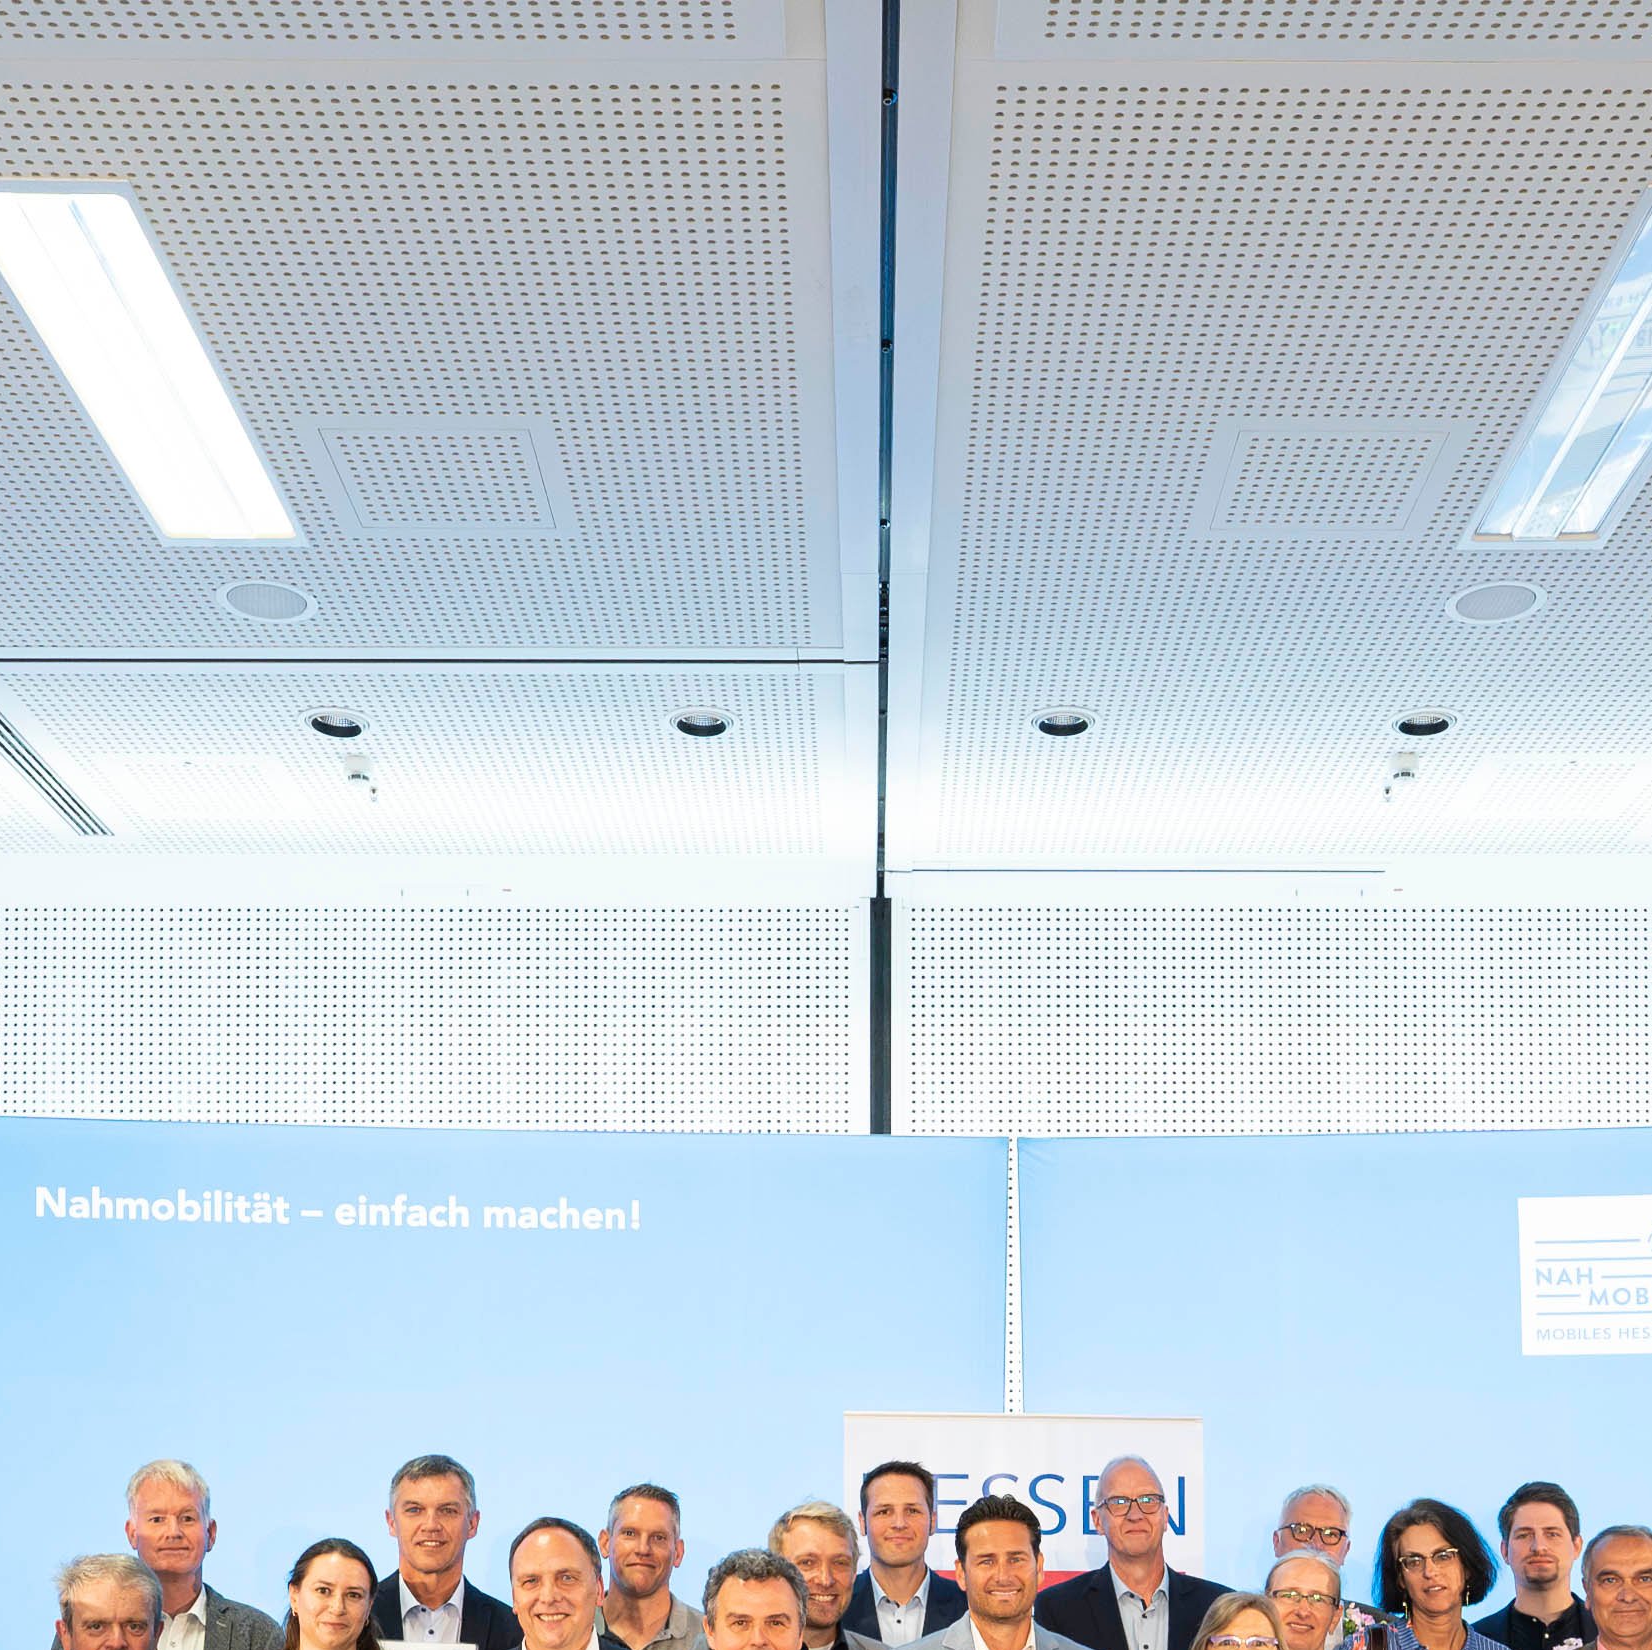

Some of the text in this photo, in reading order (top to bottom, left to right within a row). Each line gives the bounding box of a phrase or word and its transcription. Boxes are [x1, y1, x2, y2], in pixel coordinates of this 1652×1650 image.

[34, 1185, 291, 1225] Nahmobilität
[333, 1193, 470, 1227] einfach
[482, 1198, 641, 1231] machen!
[1535, 1266, 1594, 1287] NAH
[1536, 1326, 1612, 1341] MOBILES
